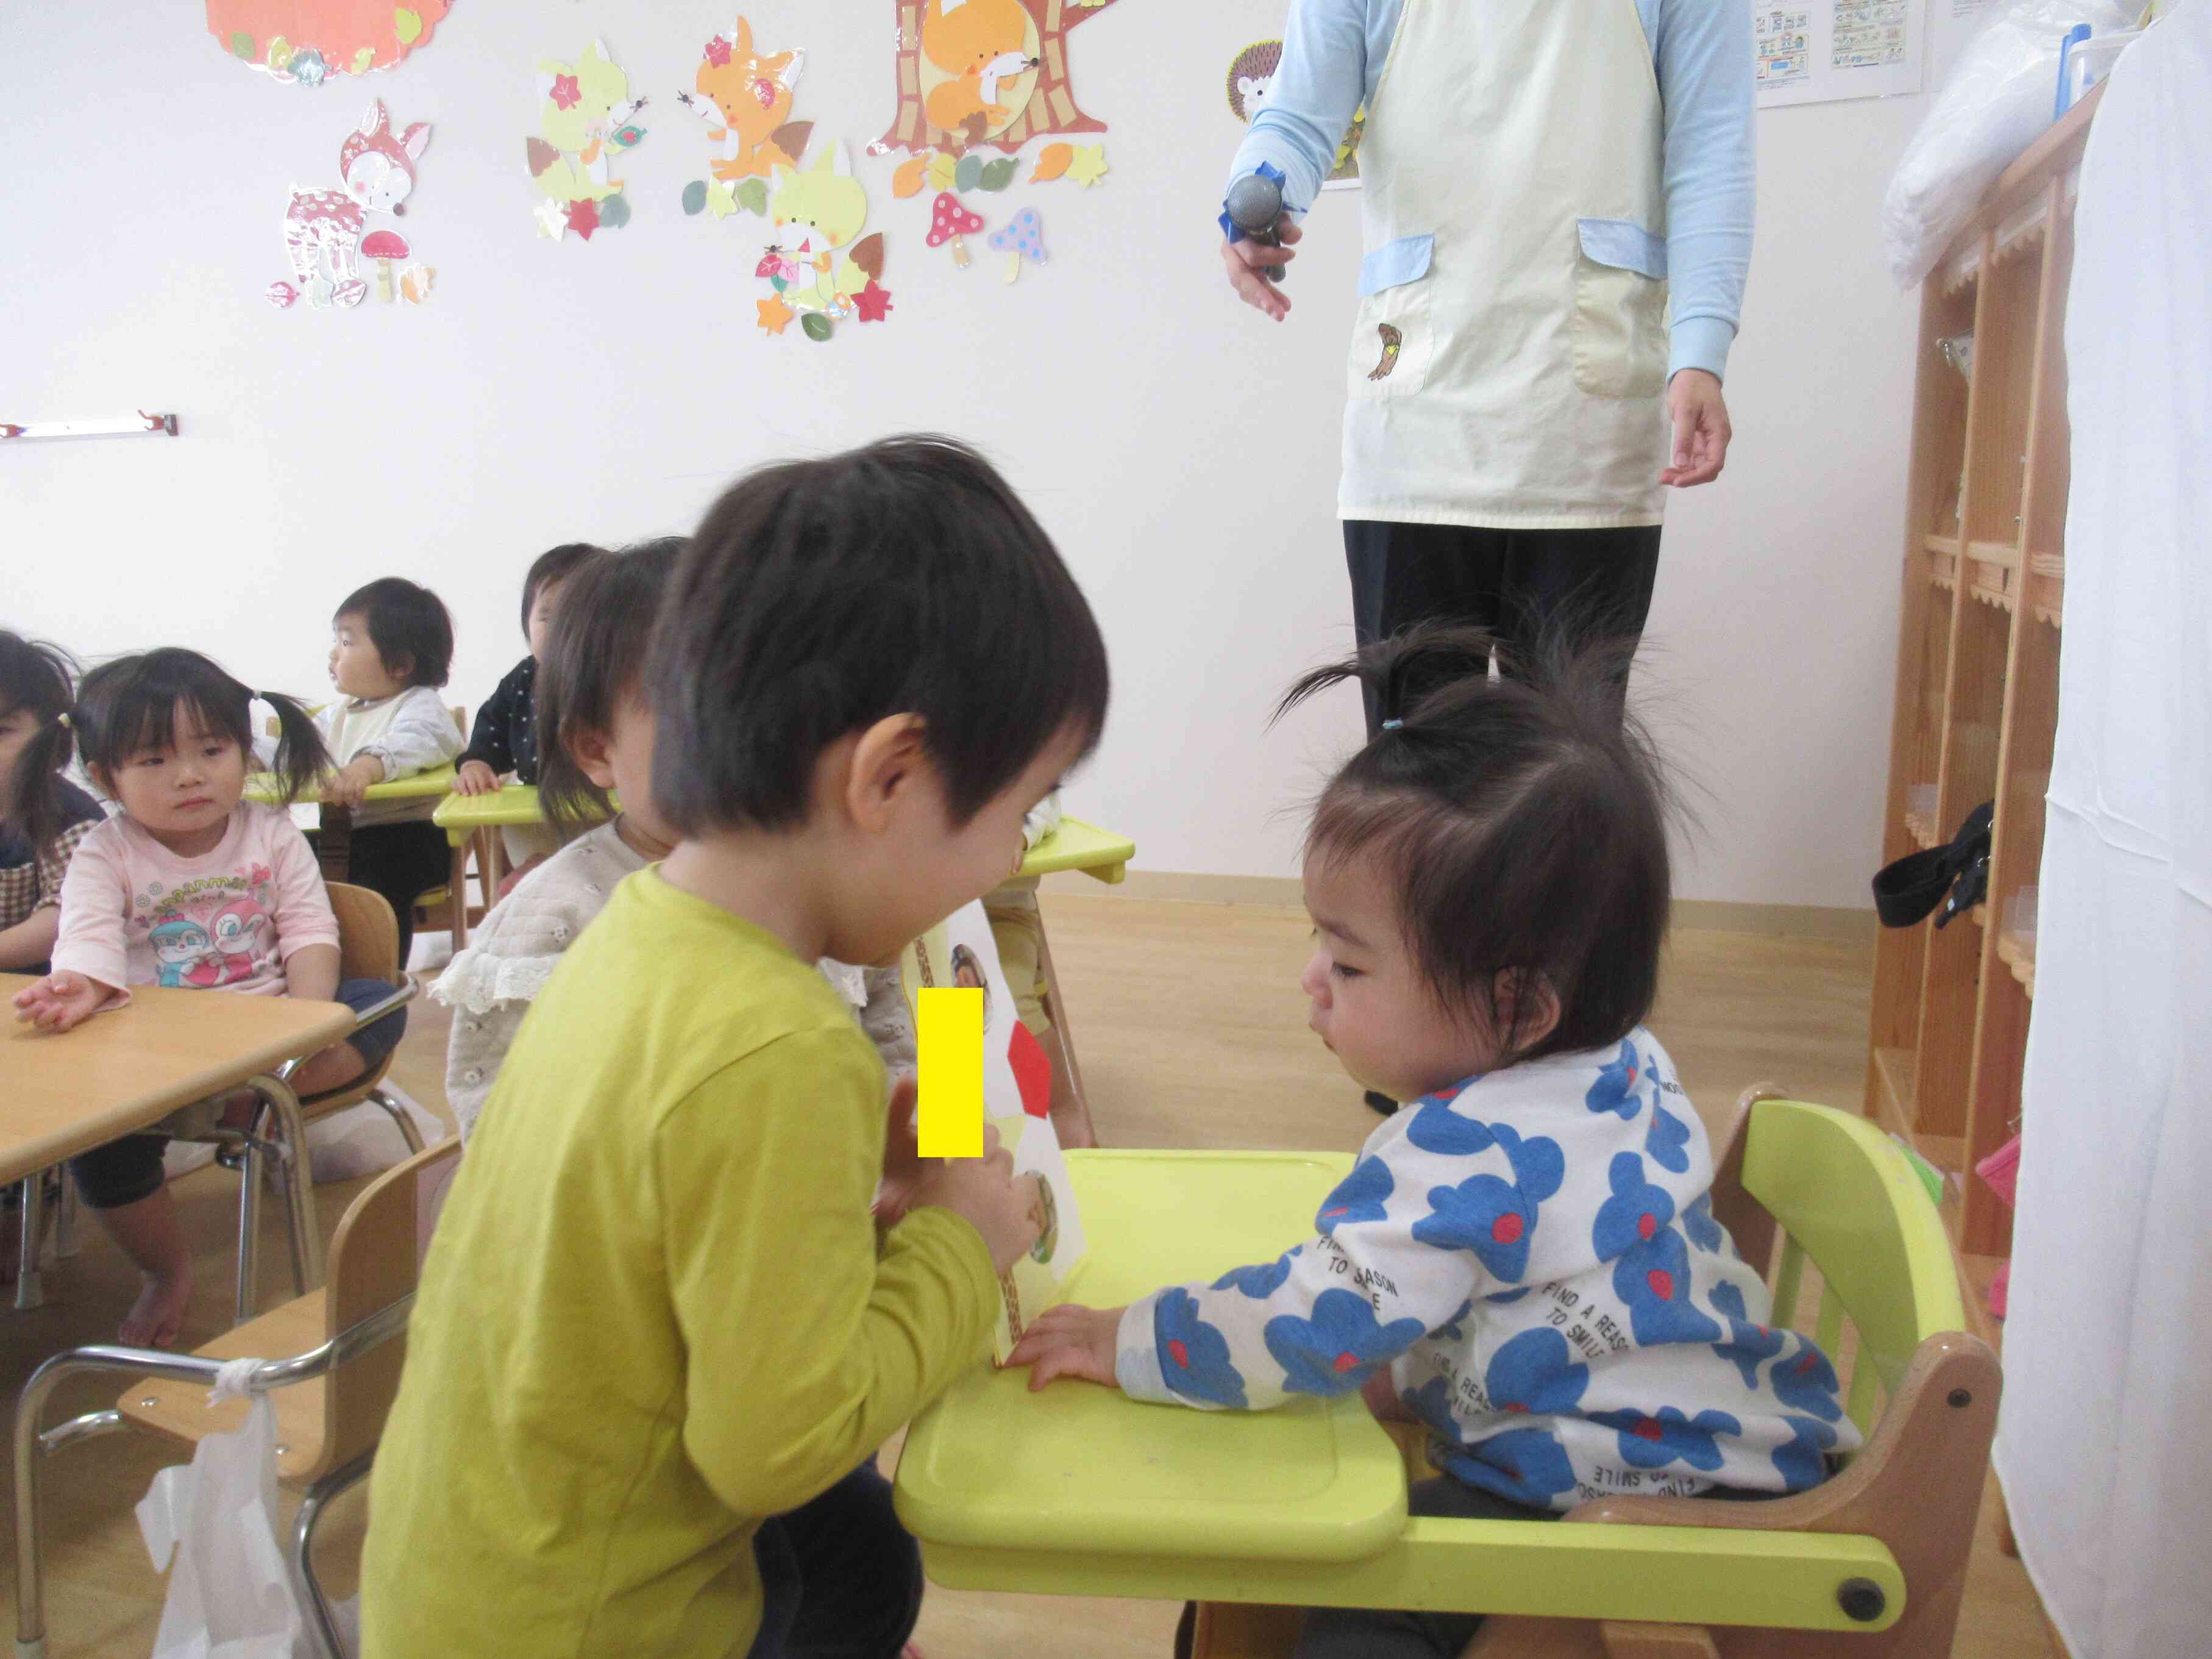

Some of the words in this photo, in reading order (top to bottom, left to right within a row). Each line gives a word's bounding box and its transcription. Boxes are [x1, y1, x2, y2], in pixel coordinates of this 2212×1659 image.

[1328, 1256, 1348, 1274] TO
[1542, 1281, 1579, 1307] FIND
[1580, 1304, 1595, 1320] A
[1546, 1307, 1568, 1326] TO
[1593, 1465, 1643, 1488] SMILE
